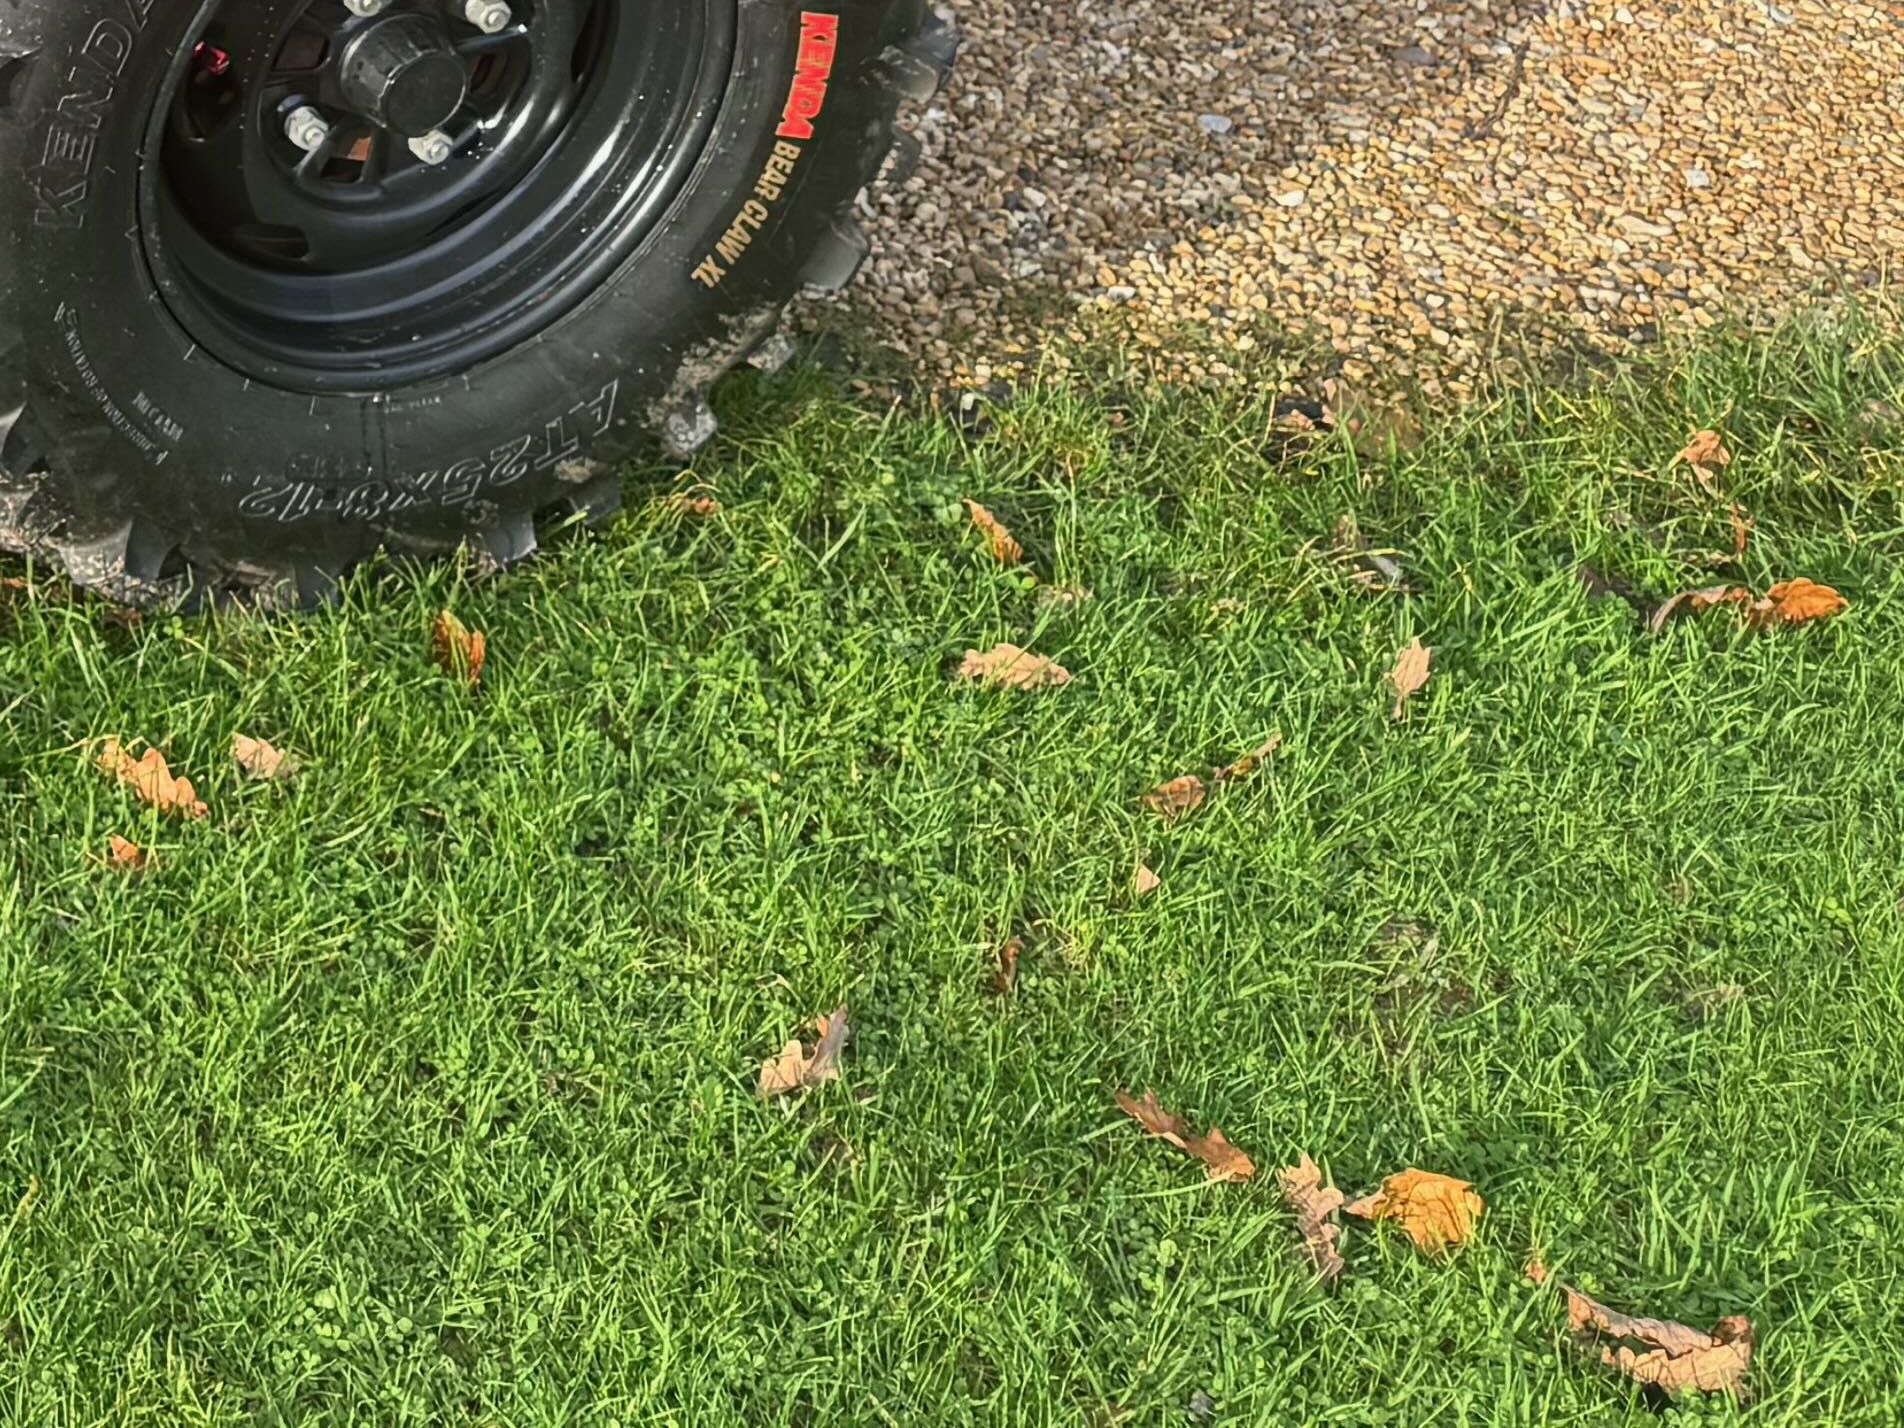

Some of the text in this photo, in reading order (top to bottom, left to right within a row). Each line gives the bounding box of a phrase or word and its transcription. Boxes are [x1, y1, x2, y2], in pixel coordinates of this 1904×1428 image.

[690, 11, 840, 289] KENDA BEAR CLAW XL
